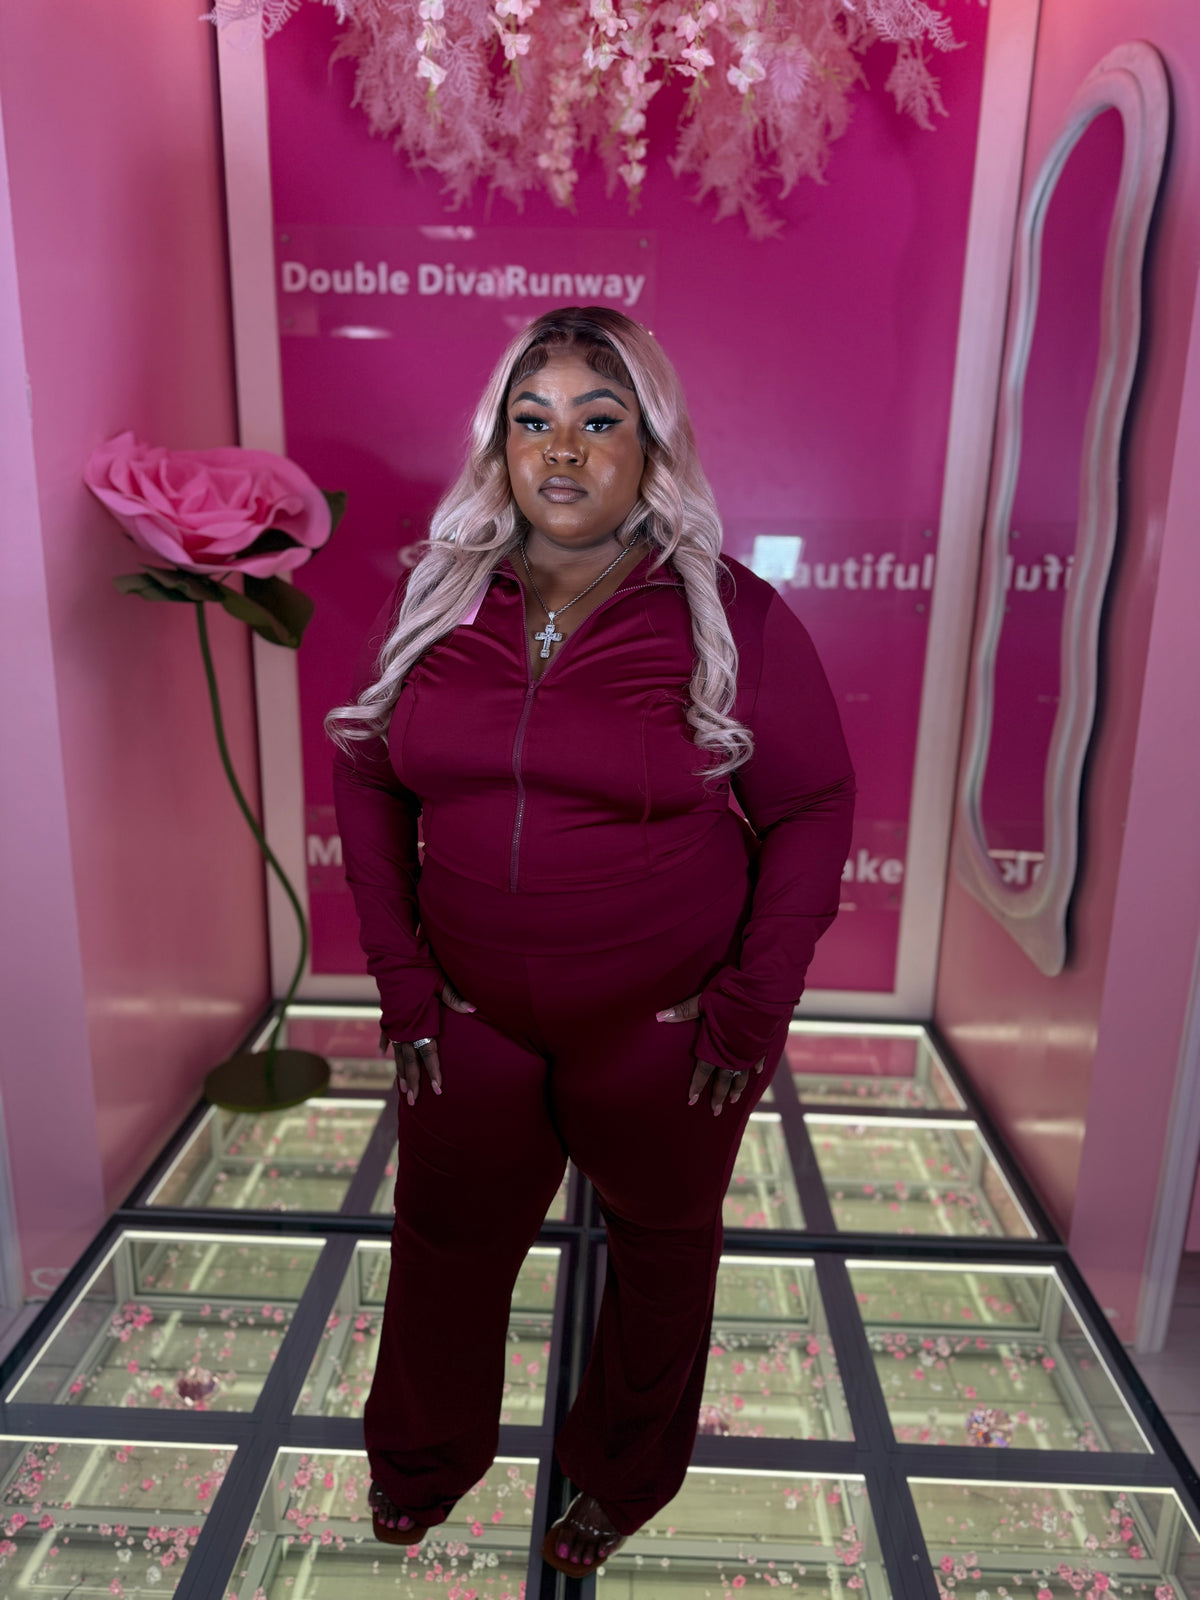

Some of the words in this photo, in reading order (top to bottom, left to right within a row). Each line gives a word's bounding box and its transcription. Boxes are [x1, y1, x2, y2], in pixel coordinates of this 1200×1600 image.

[282, 261, 410, 294] Double
[418, 262, 495, 296] Diva
[504, 264, 646, 306] Runway
[742, 553, 934, 590] autiful
